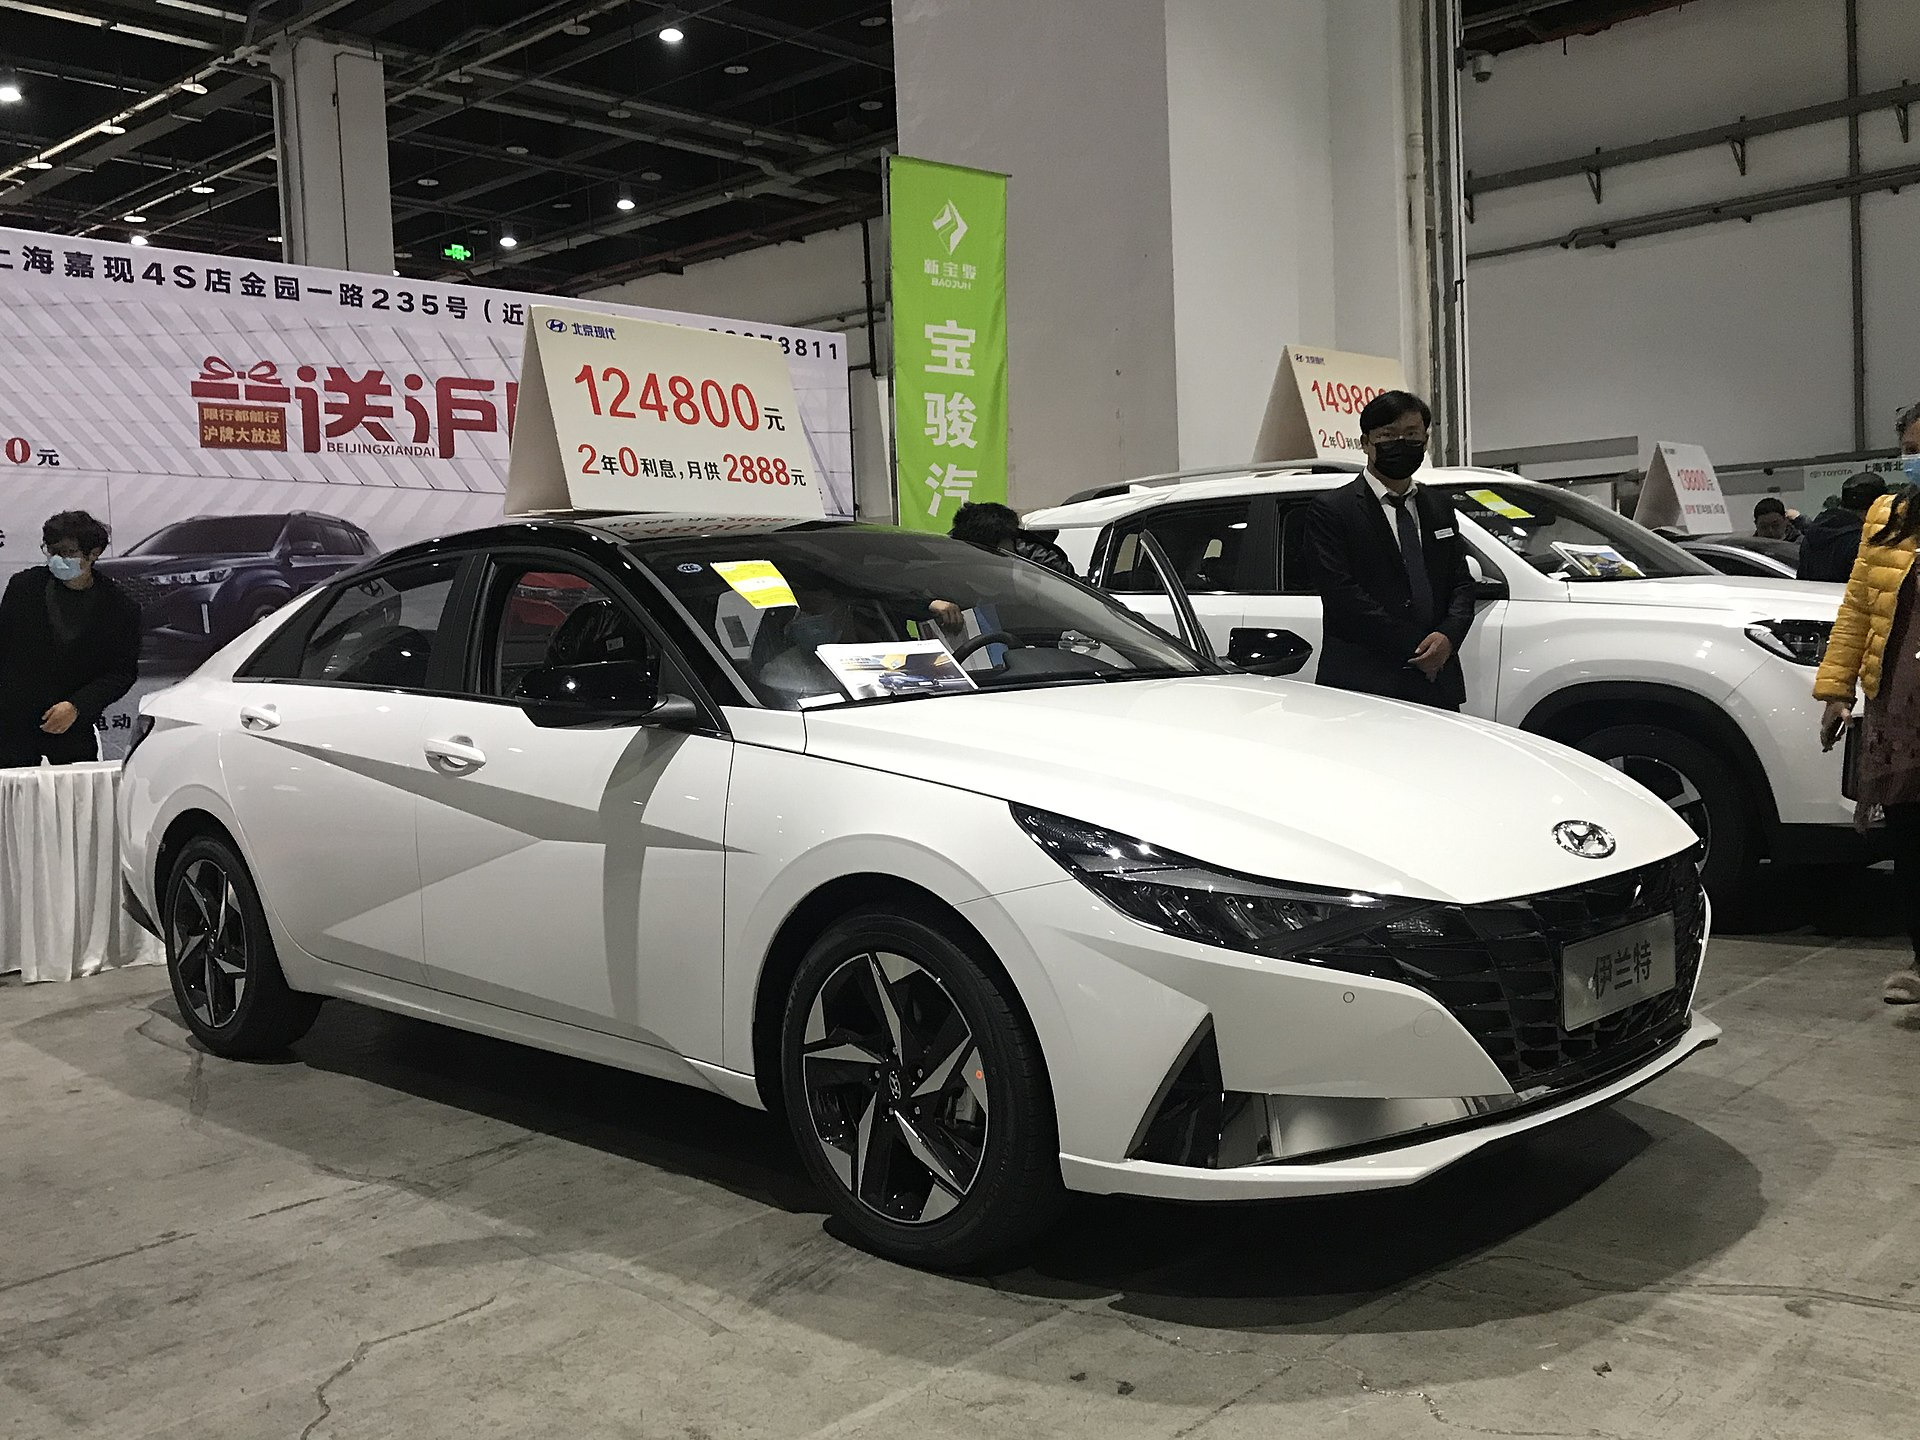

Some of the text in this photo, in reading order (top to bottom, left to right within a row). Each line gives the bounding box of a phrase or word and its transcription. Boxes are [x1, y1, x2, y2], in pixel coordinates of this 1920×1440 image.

[931, 278, 972, 290] BAOJUN
[572, 323, 616, 340] 北京现代
[574, 364, 786, 432] 124800元
[294, 365, 519, 459] 送沪
[203, 425, 281, 444] 沪牌大放送
[326, 442, 436, 457] BEIJINGXIANDAI
[1822, 468, 1853, 477] TOYOTA
[1592, 939, 1652, 1000] 伊兰特
